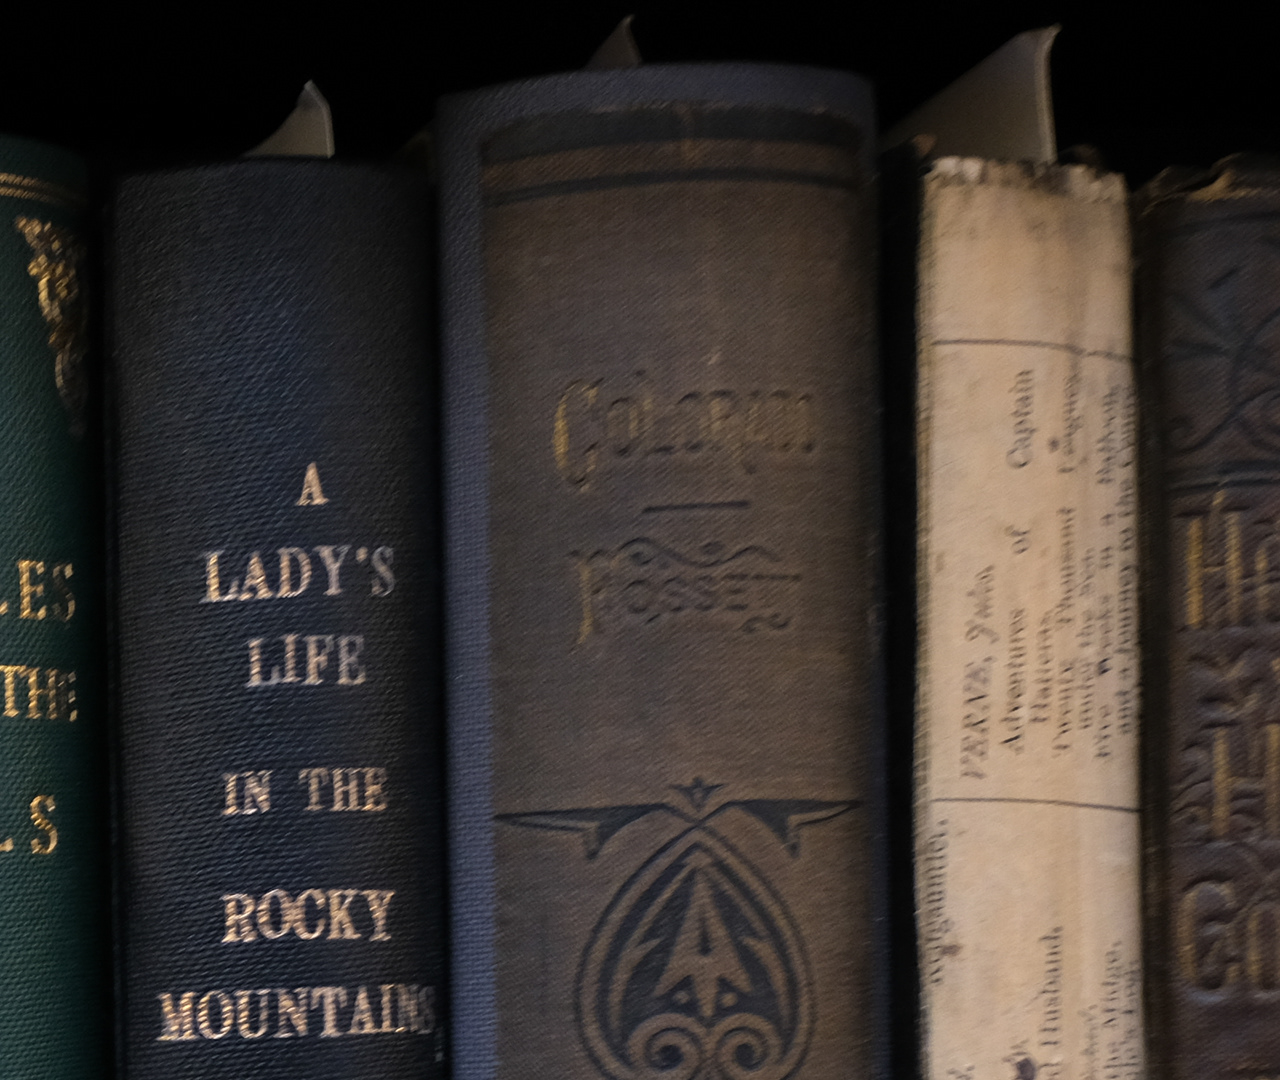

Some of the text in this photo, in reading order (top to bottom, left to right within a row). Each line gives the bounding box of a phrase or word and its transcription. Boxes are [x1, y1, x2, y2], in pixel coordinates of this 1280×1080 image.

[1006, 369, 1038, 469] Captain
[293, 460, 330, 507] A
[1005, 525, 1031, 555] of
[198, 544, 396, 604] LADY'S
[243, 632, 367, 688] LIFE
[219, 765, 389, 816] IN THE
[219, 887, 396, 944] ROCKY
[154, 982, 437, 1042] MOUNTAINS
